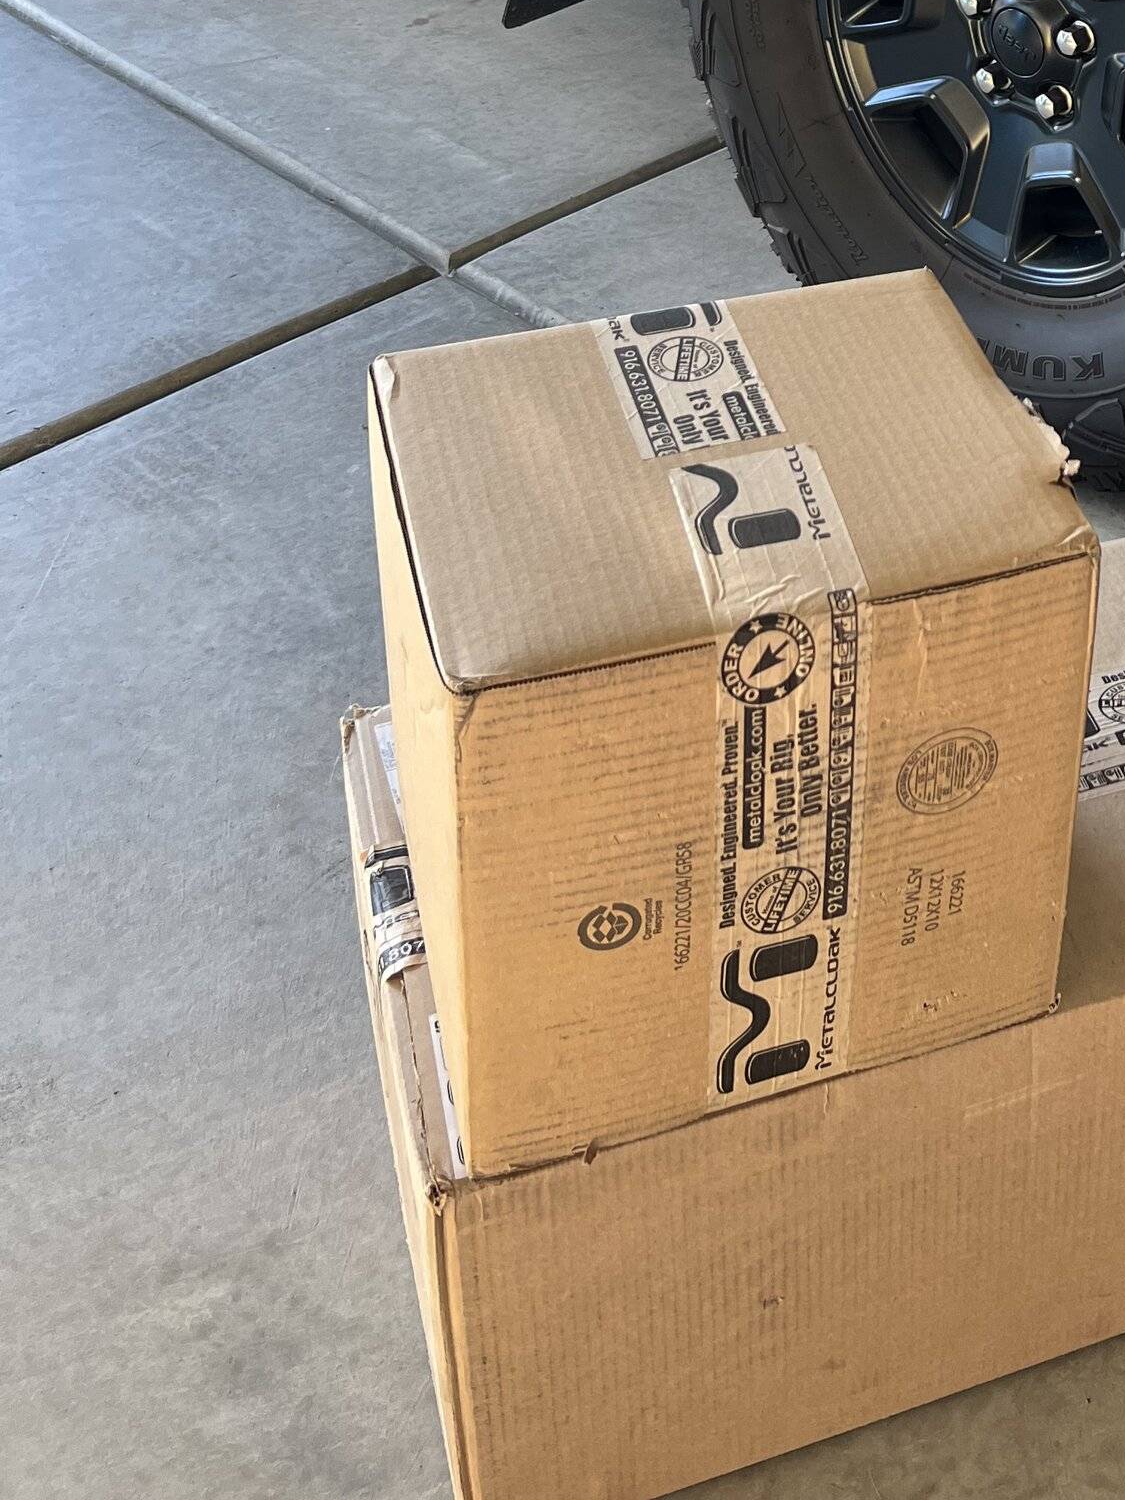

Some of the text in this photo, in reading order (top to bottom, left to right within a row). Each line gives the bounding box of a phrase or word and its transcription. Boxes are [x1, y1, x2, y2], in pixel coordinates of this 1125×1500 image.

[622, 349, 661, 427] 916.631.8071
[676, 337, 695, 381] LIFETIME
[976, 337, 1104, 382] KUM
[673, 414, 704, 445] Only
[687, 389, 729, 441] It's Your
[724, 643, 760, 702] ORDER
[775, 613, 815, 678] ONLINE
[745, 708, 765, 845] metalcloak.com
[797, 703, 823, 818] Only Better.
[720, 777, 738, 864] Engineered.
[773, 776, 796, 824] Your
[775, 822, 798, 855] It's
[827, 808, 848, 914] 916.631.8071
[719, 862, 738, 929] Designed.
[744, 872, 783, 927] CUSTOMER
[762, 868, 802, 933] LIFETIME
[792, 877, 819, 924] SERVICE
[924, 868, 944, 932] 12X12X10
[948, 870, 966, 916] 166221
